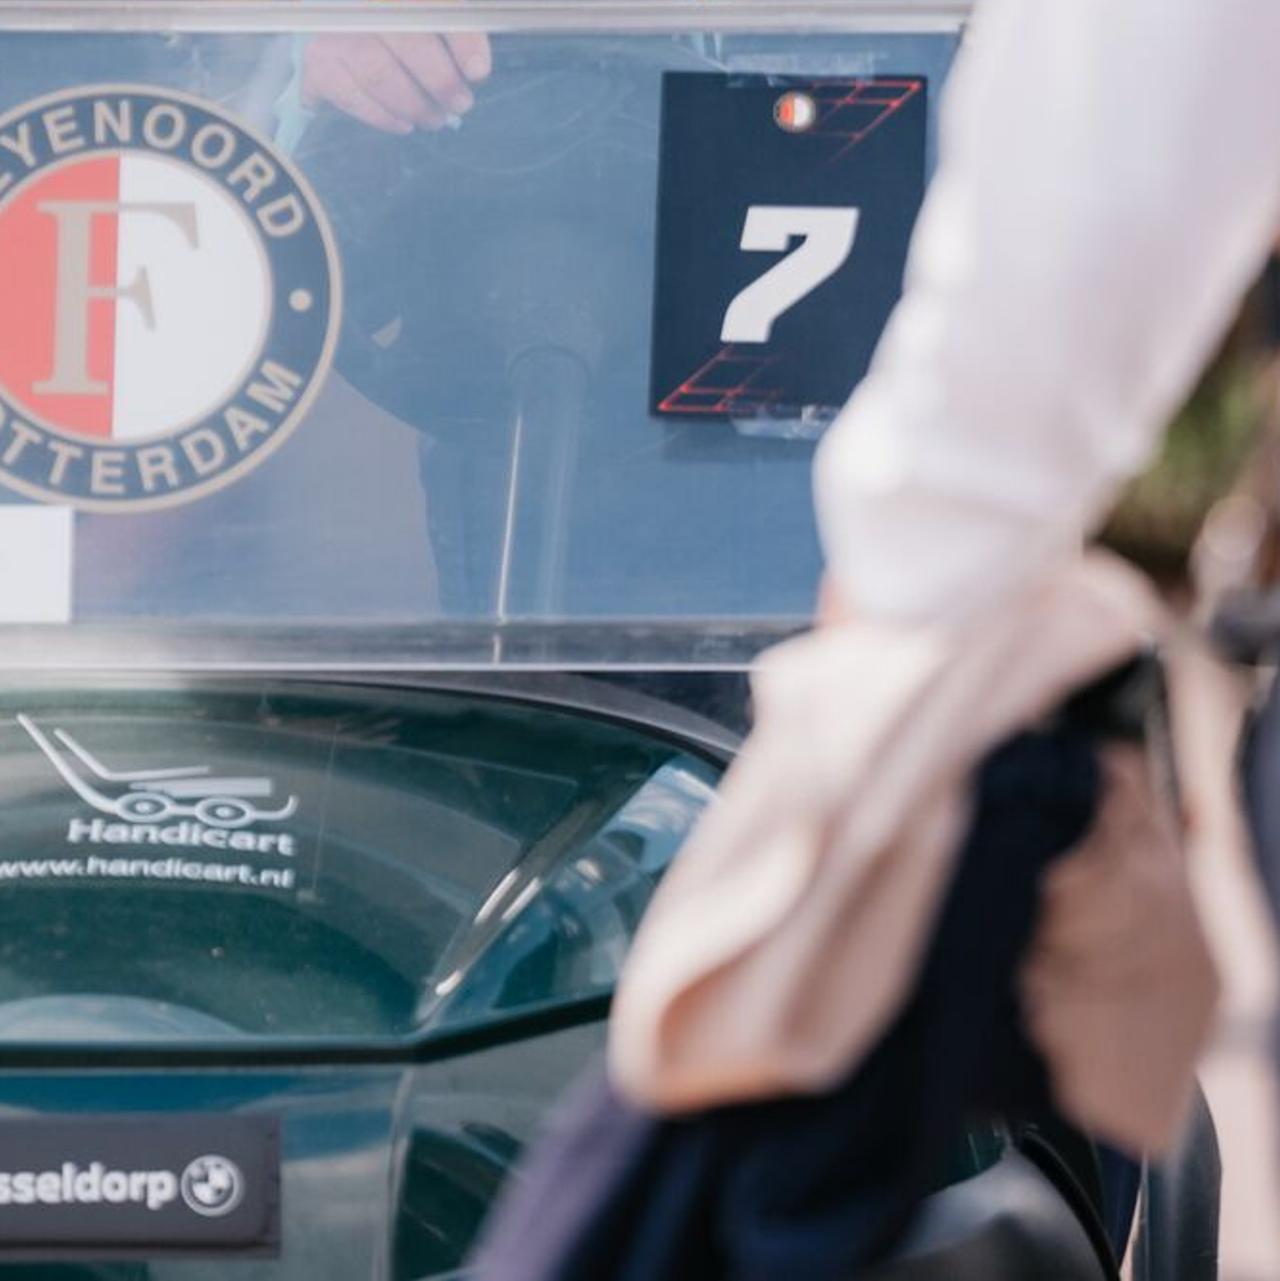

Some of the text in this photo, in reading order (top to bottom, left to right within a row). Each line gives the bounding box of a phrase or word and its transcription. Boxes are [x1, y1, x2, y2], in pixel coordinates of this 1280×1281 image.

[32, 200, 200, 396] F
[720, 205, 860, 343] 7
[67, 818, 297, 856] Handicart
